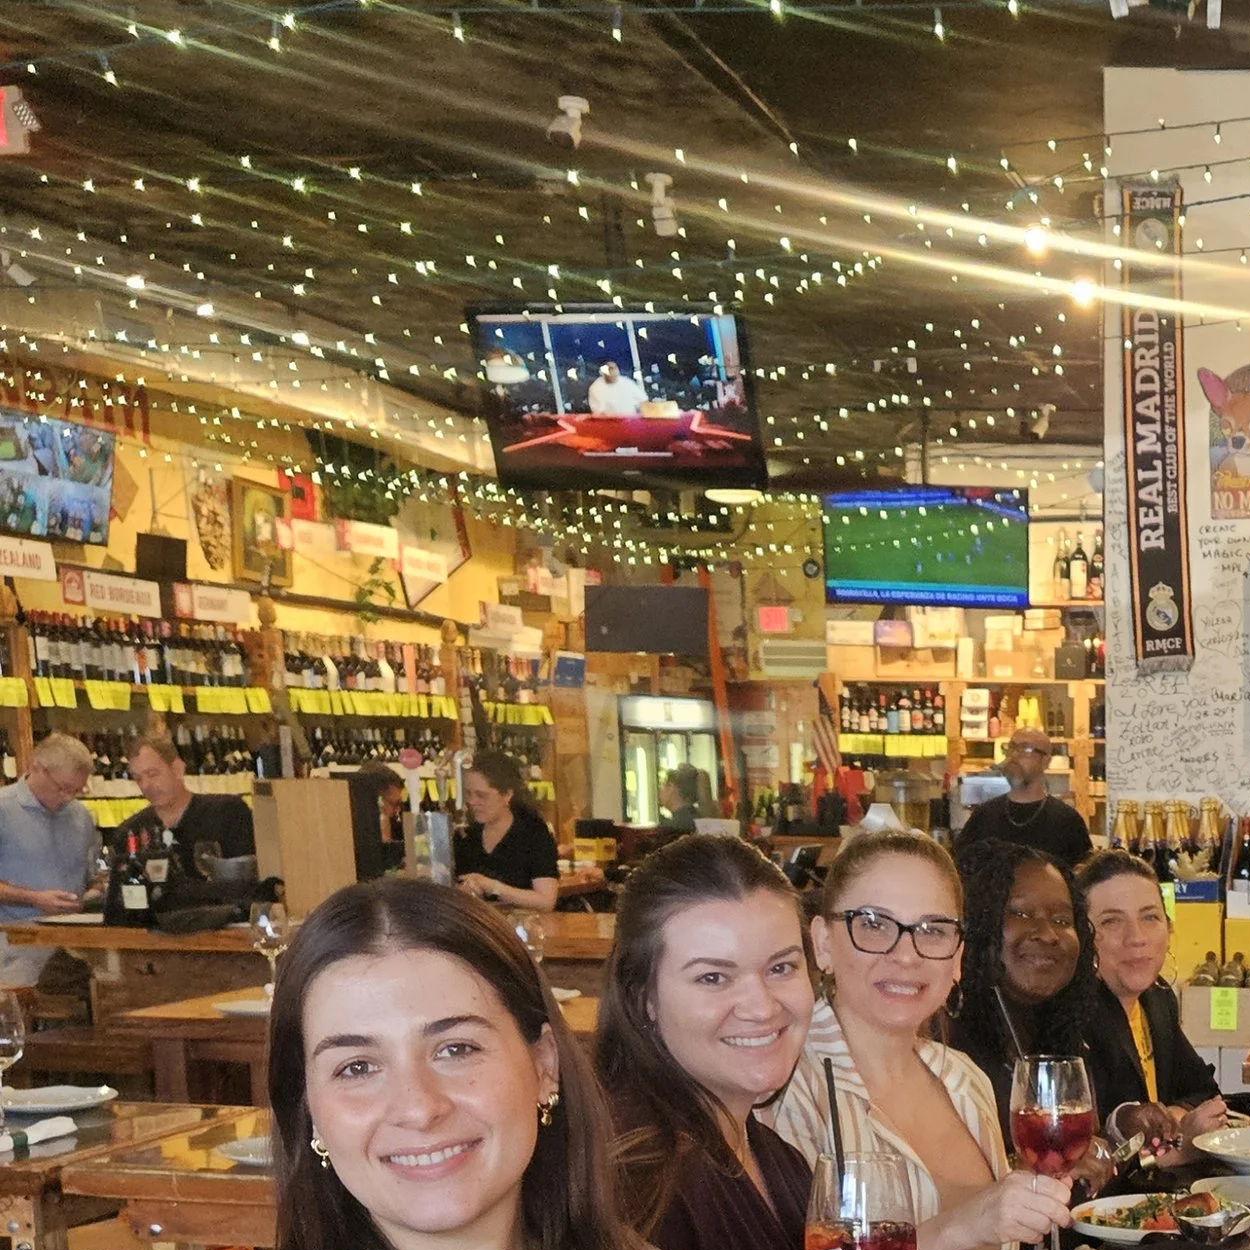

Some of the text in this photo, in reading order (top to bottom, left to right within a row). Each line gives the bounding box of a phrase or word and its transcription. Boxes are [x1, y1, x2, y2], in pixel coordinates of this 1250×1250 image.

[1134, 306, 1166, 551] REAL MADRID
[1163, 341, 1179, 515] BEST CLUB OF THE WORLD
[1213, 491, 1234, 510] NO
[1202, 548, 1243, 560] MAGIC
